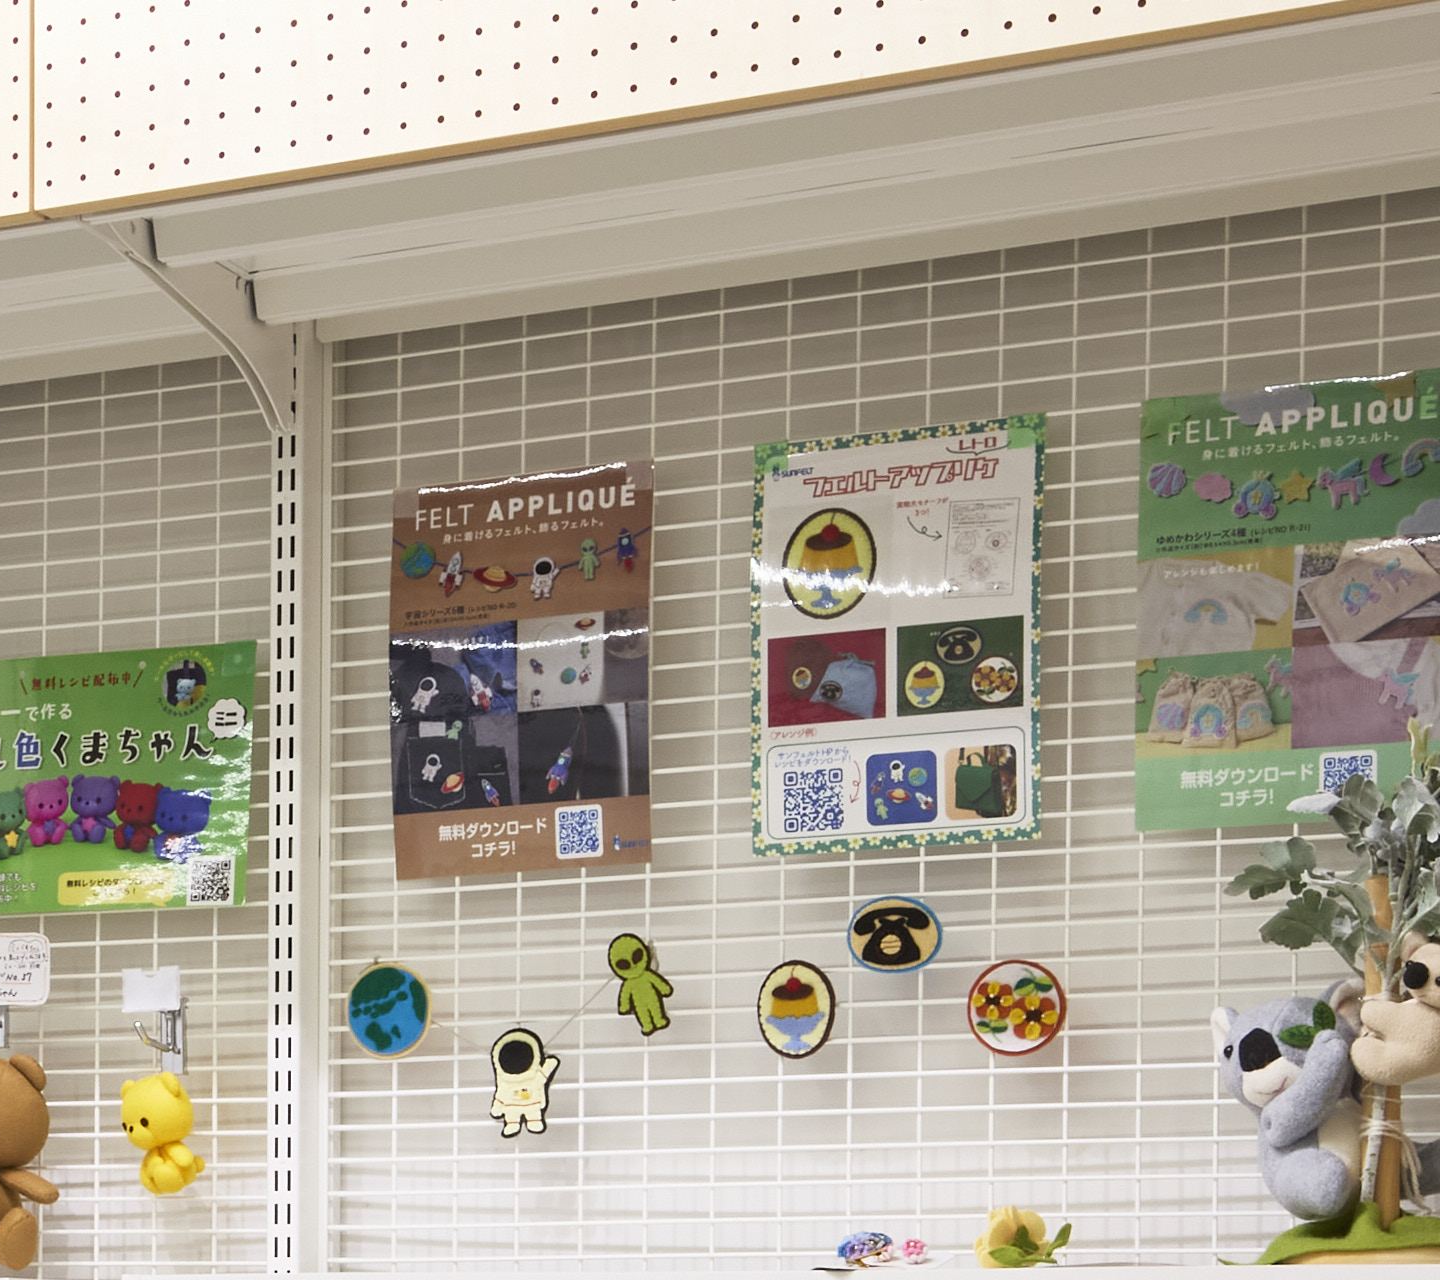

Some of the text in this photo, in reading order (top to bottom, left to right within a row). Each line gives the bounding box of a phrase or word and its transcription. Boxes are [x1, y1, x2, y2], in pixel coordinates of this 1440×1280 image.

[1167, 385, 1439, 446] FELT APPLIQUÉ
[959, 436, 997, 450] レトロ
[1201, 432, 1401, 461] 身に着けるフェルト、飾るフェルト。
[781, 467, 813, 479] SUNFELT
[415, 478, 637, 531] FELT APPLIQUÉ
[442, 519, 605, 545] 身に着けるフェルト、飾るフェルト。
[31, 672, 132, 691] 無料レシピ配布中
[215, 711, 238, 726] ミニ
[1180, 763, 1314, 789] 無料ダウンロード
[438, 817, 548, 842] 無料ダウンロード
